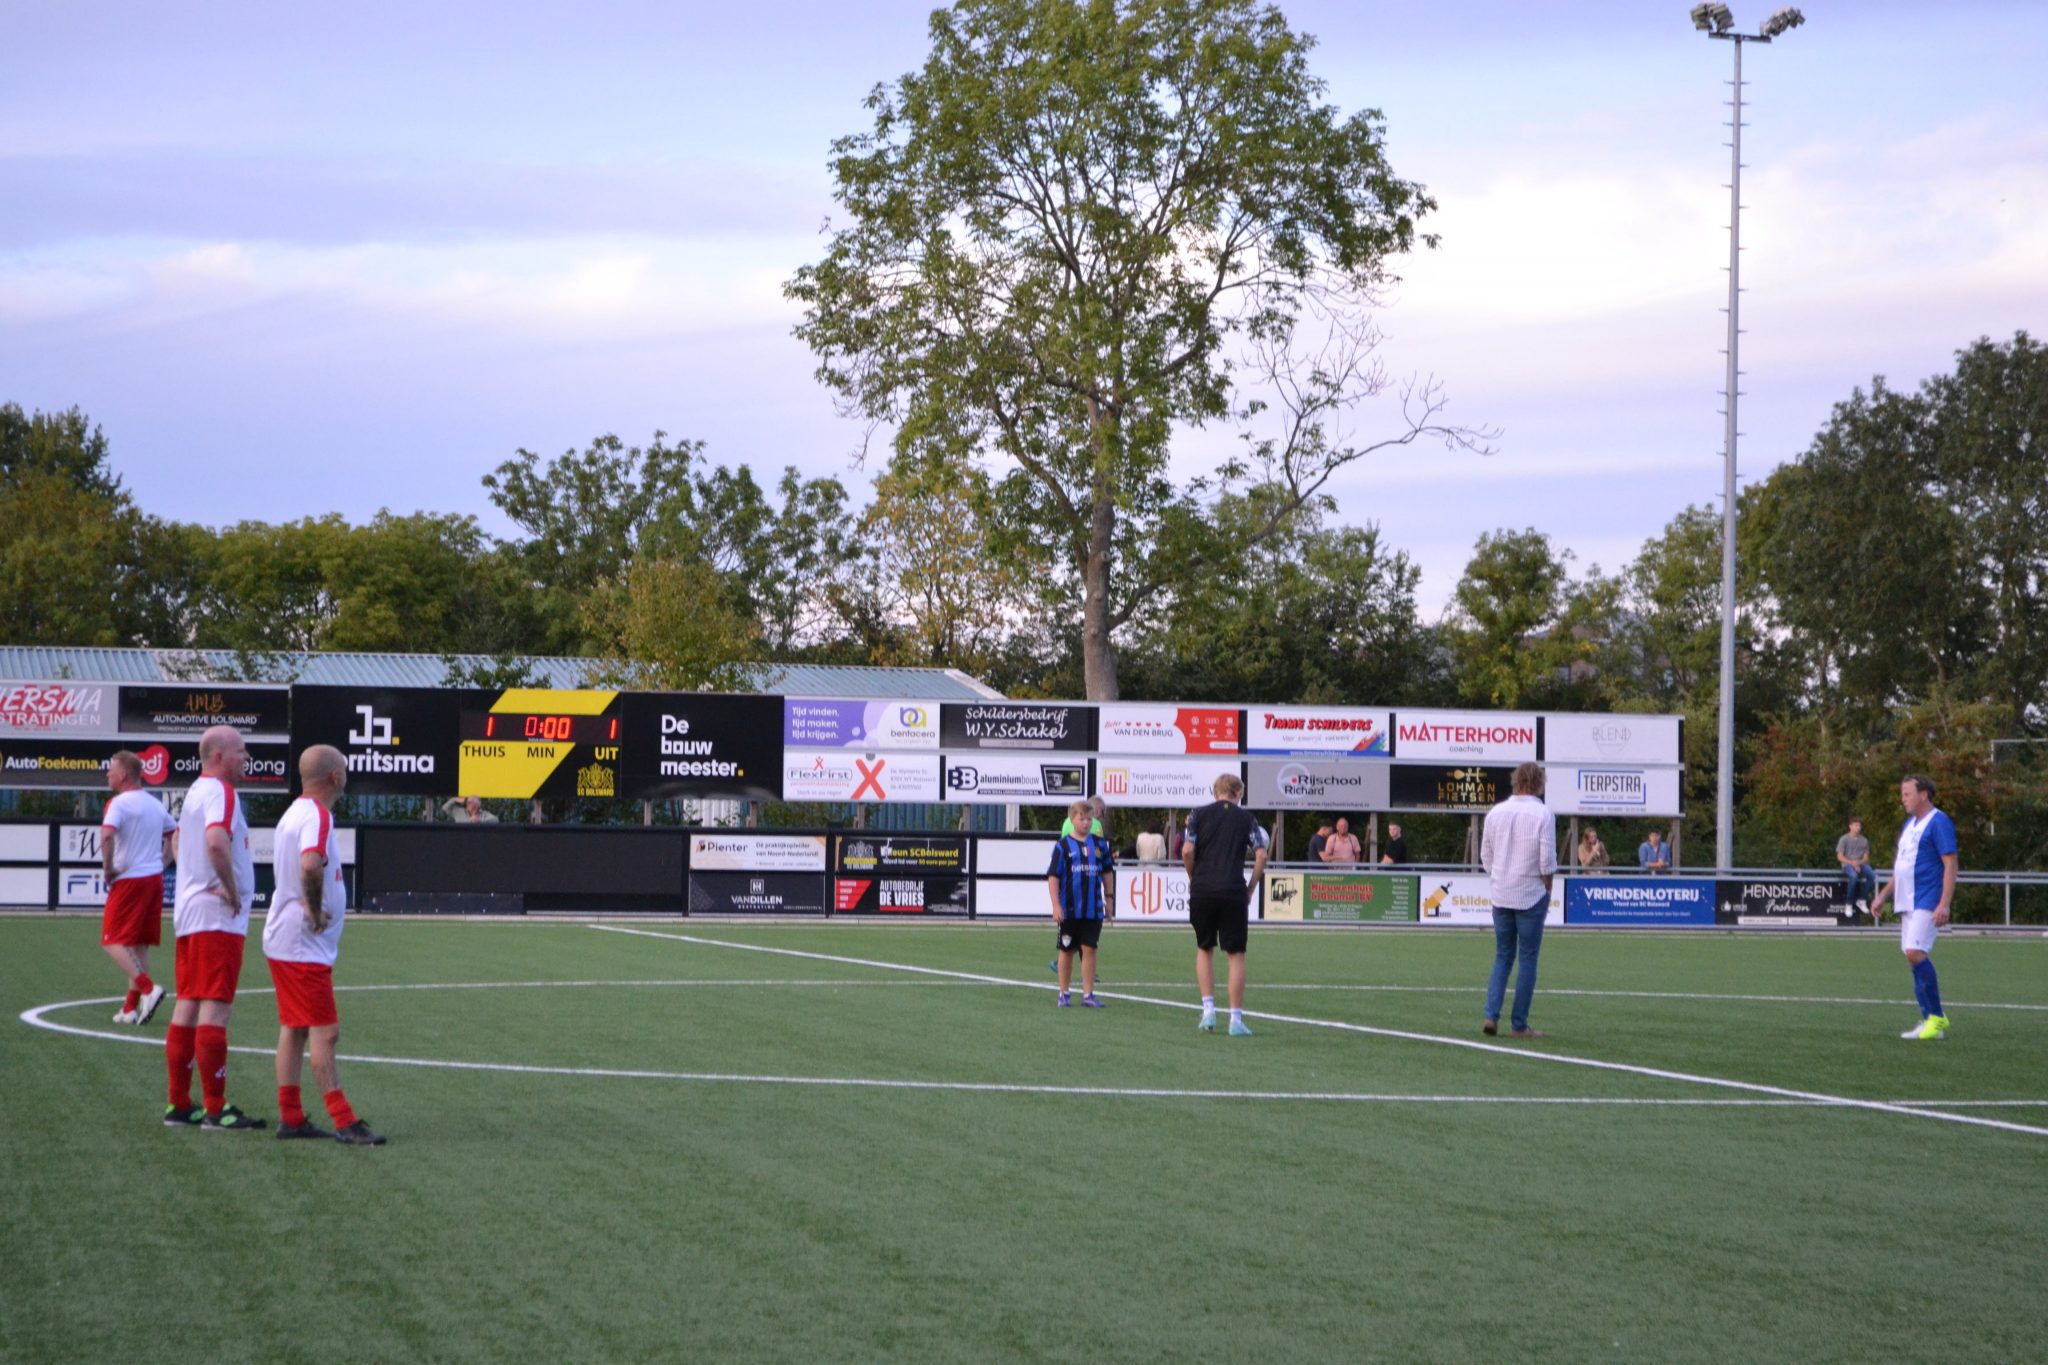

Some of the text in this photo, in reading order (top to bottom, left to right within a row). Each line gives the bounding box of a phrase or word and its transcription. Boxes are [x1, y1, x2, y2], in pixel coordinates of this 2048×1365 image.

[792, 707, 806, 718] Tijd
[965, 706, 1068, 724] Schildersbedrijf
[153, 714, 257, 725] AUTOMOTIVE BOLSWARD
[661, 714, 689, 734] De
[792, 719, 806, 730] tijd
[1307, 719, 1374, 731] SCHILDERS
[486, 717, 617, 740] 1 0:00 1
[965, 721, 1068, 739] W.Y.Schakel
[1132, 729, 1149, 737] DEN
[1399, 720, 1534, 745] MATTERHORN
[1592, 727, 1632, 742] BLEND
[792, 730, 806, 741] tijd
[661, 735, 713, 755] bouw
[1449, 746, 1484, 755] coaching
[463, 745, 619, 760] THUIS MIN UIT
[5, 757, 113, 769] AutoFoekema.nl
[341, 748, 434, 773] rritsma
[661, 759, 744, 776] meester.
[790, 771, 849, 779] FlexFirst
[980, 774, 1040, 784] aluminiumbouw
[1132, 773, 1193, 781] Tegelgroothandel
[1298, 775, 1362, 786] Rijschool
[1438, 783, 1496, 793] LOHMAN
[1583, 774, 1641, 793] TERPSTRA
[1132, 784, 1163, 796] Julius
[1166, 787, 1186, 795] van
[1188, 786, 1206, 795] der
[1284, 785, 1325, 796] Richard
[1438, 792, 1496, 803] FIETSEN
[707, 841, 748, 852] Pienter
[879, 880, 925, 892] AUTOBEDRIJF
[1744, 884, 1833, 899] HENDRIKSEN
[731, 895, 783, 905] VANDILLEN
[879, 891, 925, 907] DE VRIES
[1584, 887, 1700, 902] VRIENDENLOTERIJ
[1765, 899, 1810, 914] Fashion
